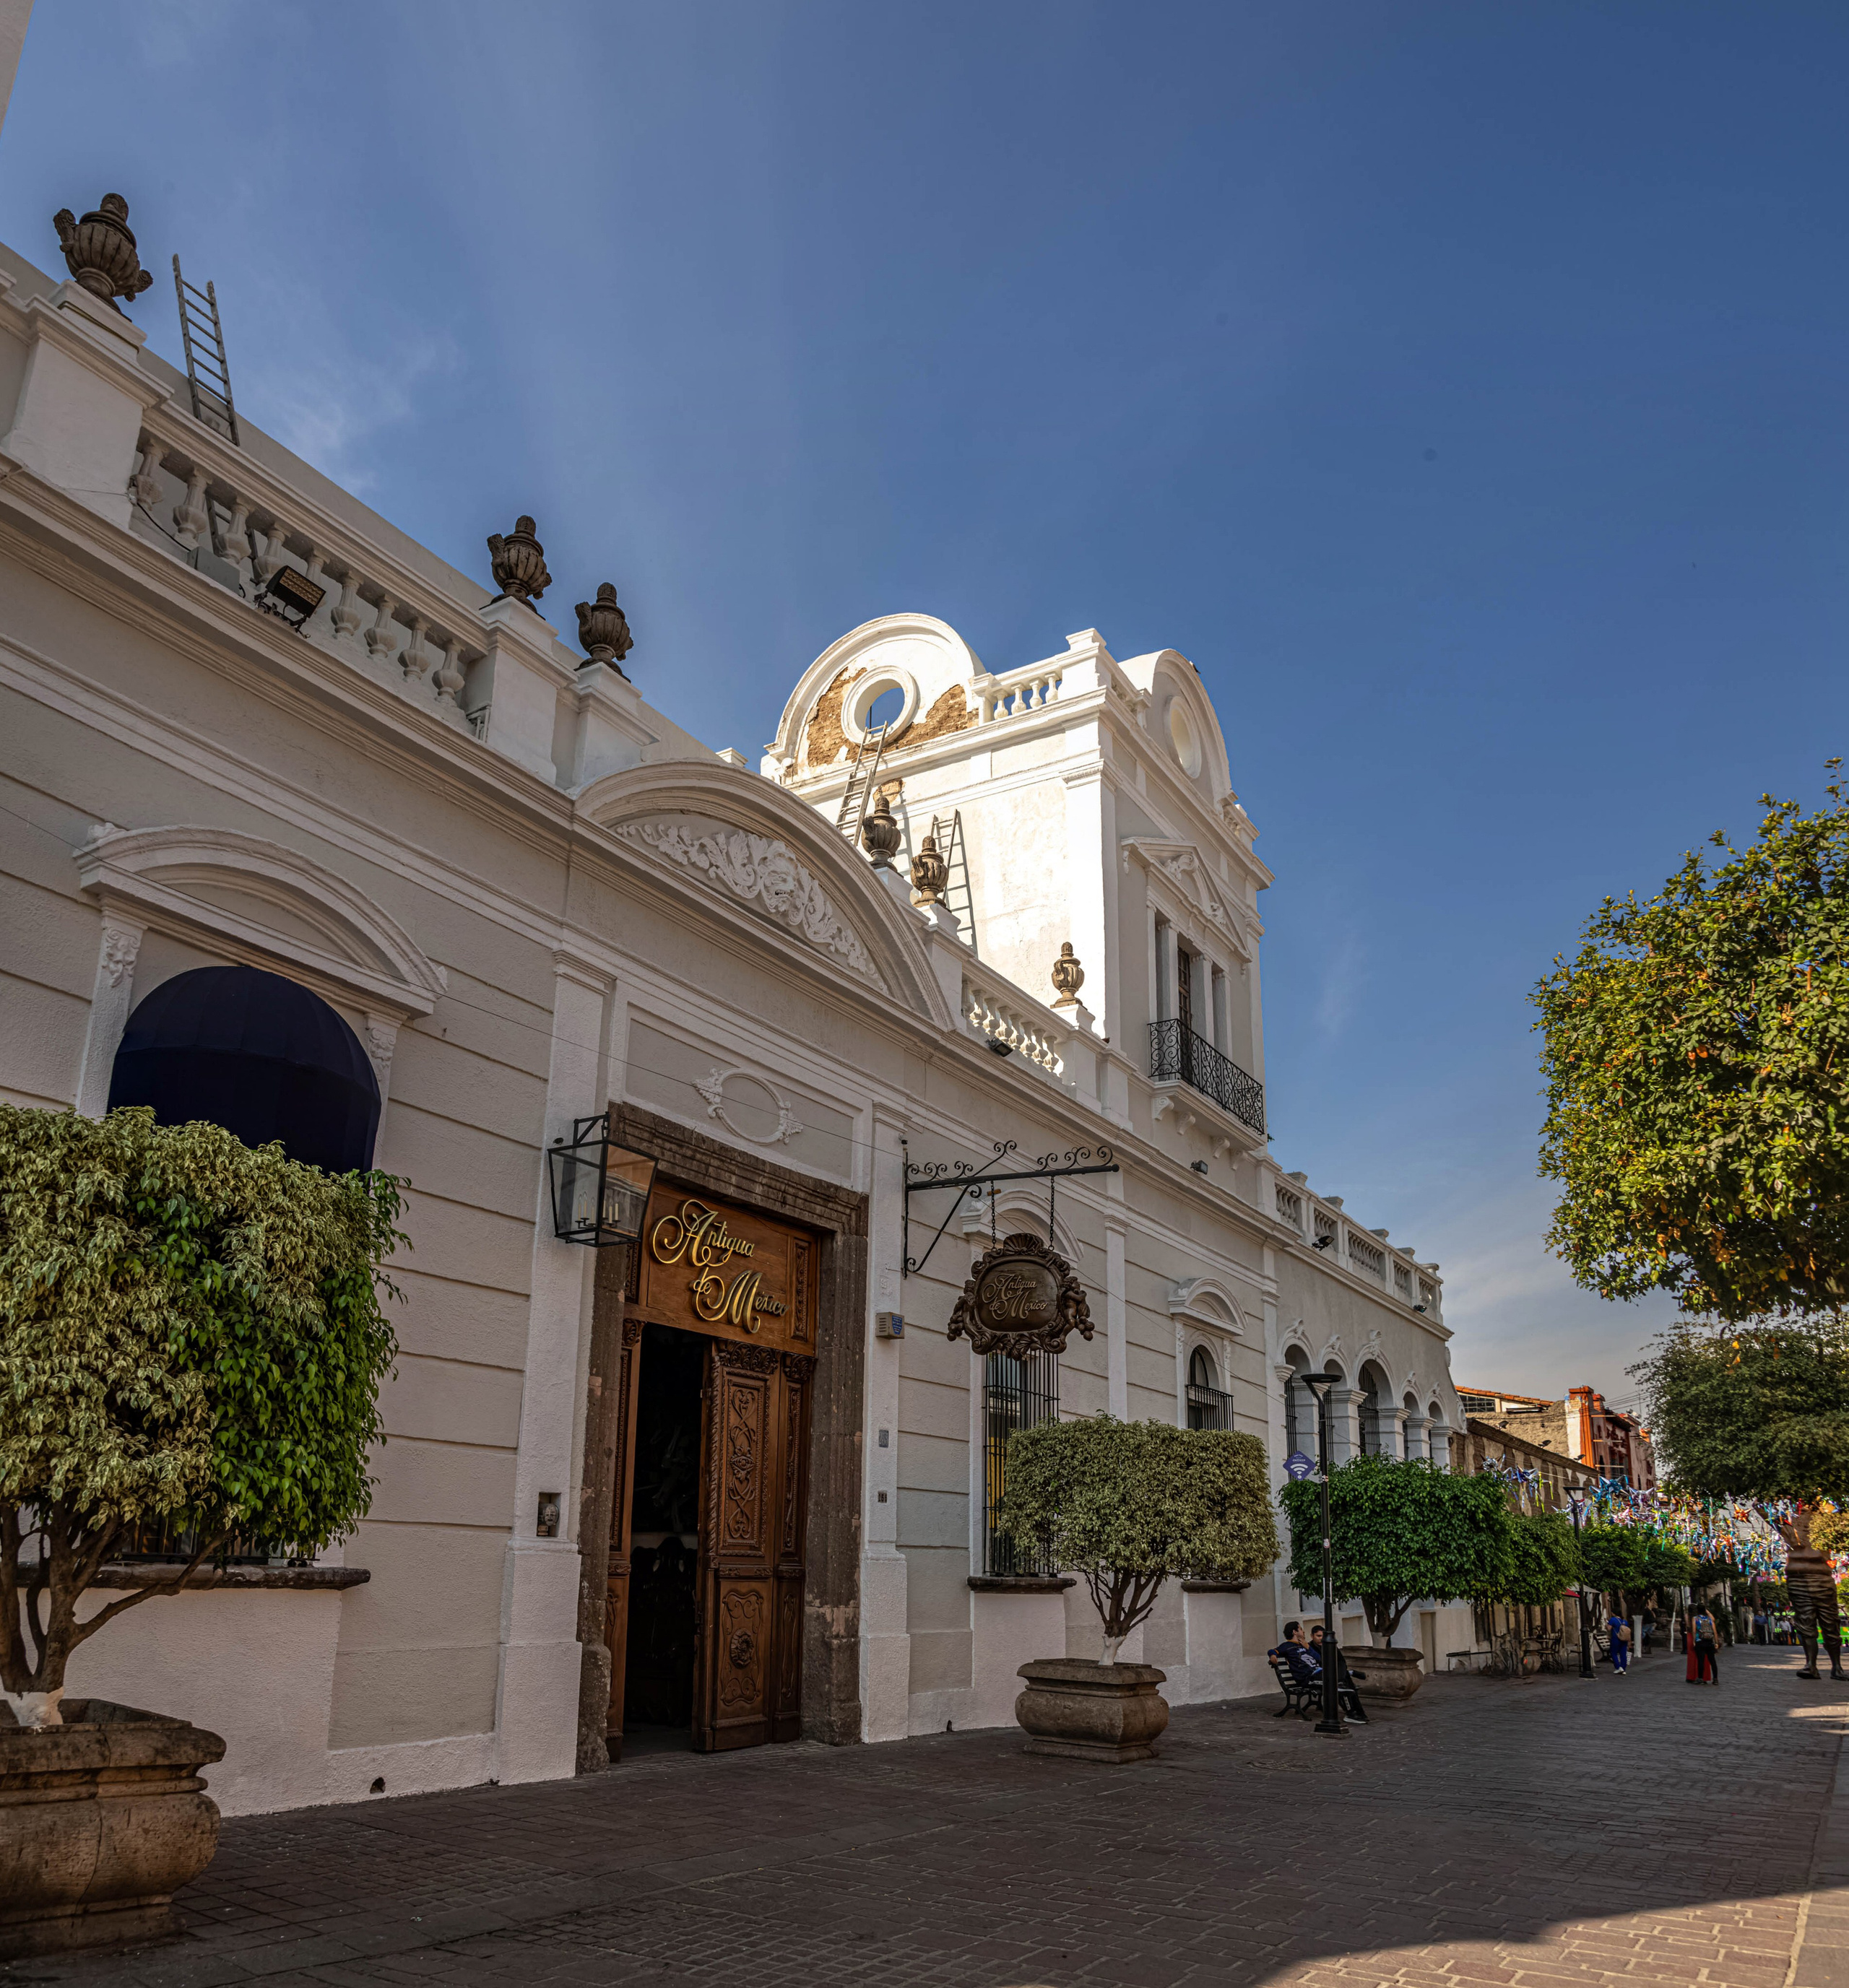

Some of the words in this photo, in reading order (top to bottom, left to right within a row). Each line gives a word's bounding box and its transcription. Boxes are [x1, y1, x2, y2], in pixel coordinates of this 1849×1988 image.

[653, 1199, 754, 1267] Antigua
[693, 1267, 711, 1294] de
[982, 1274, 1037, 1303] Antigua
[990, 1298, 1000, 1311] de
